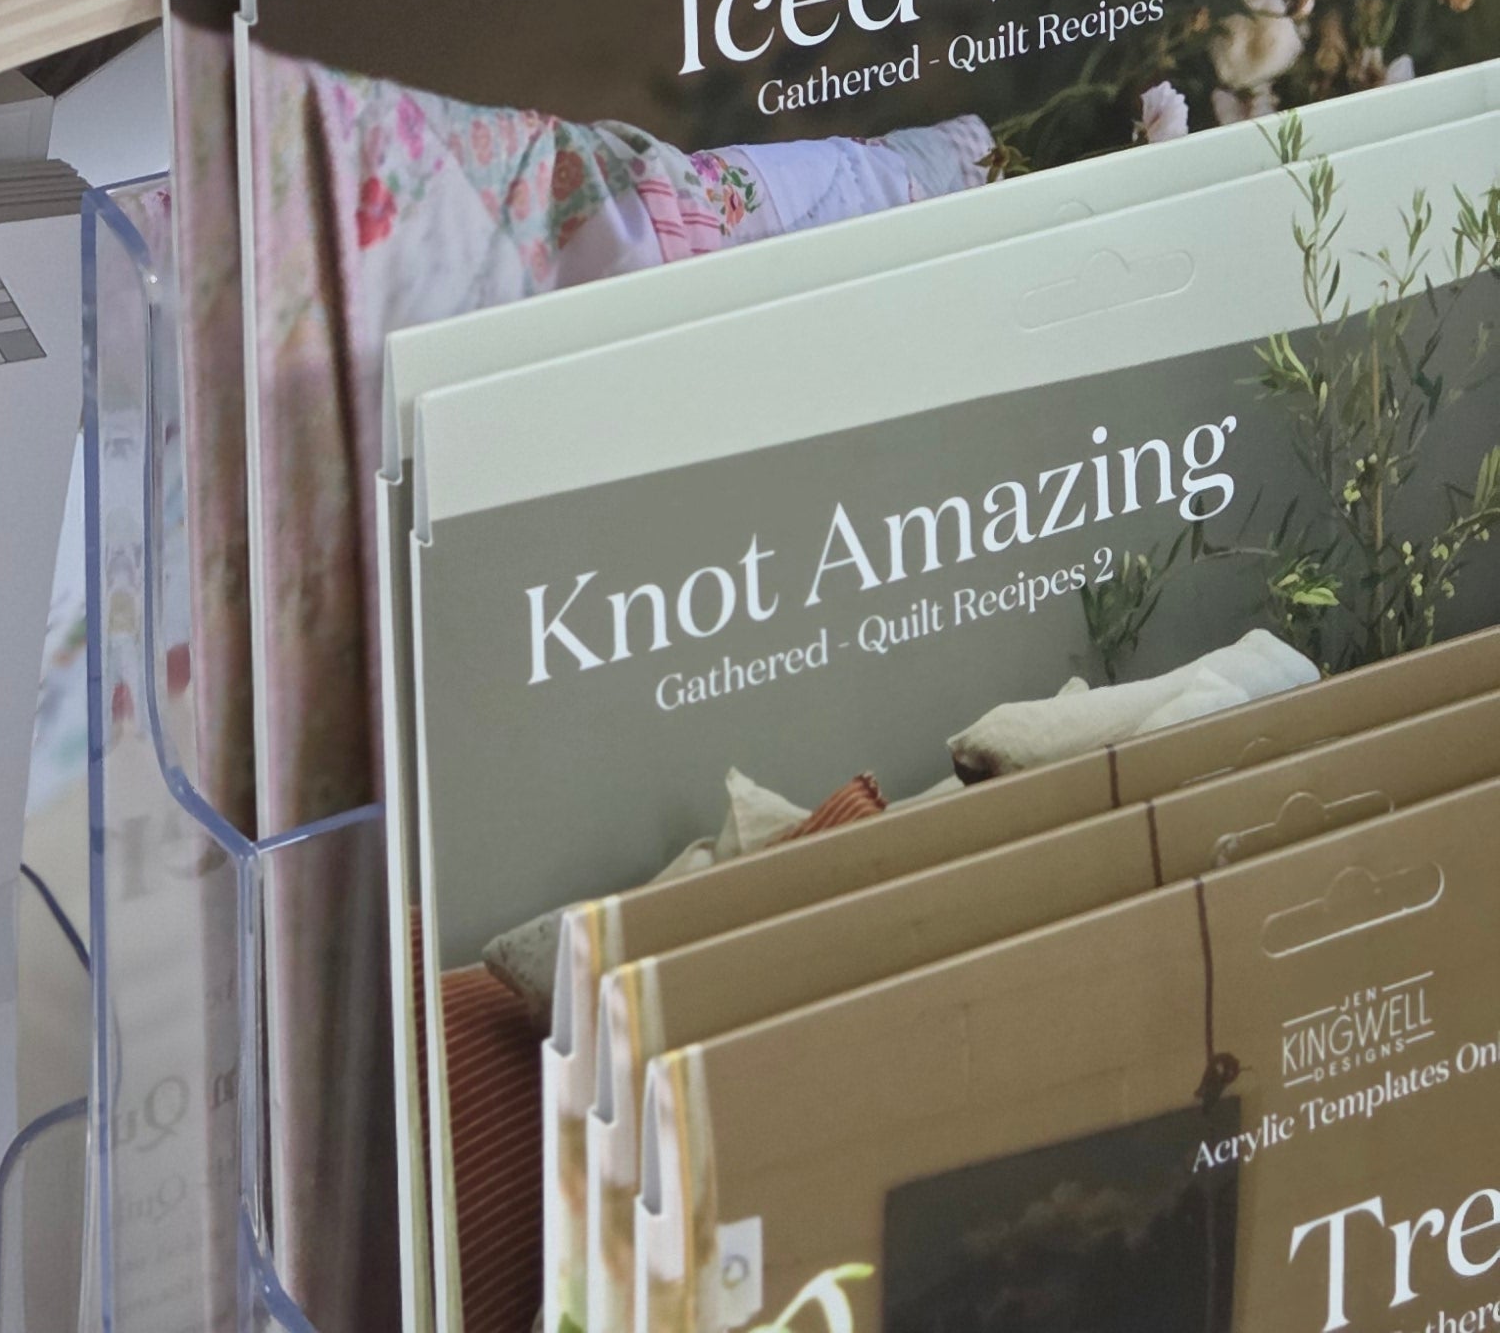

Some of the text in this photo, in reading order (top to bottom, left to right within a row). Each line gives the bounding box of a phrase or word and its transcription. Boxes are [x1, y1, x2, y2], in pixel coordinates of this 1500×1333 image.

[757, 44, 920, 116] Gathered
[948, 23, 1030, 72] Quilt
[524, 415, 1238, 685] Knot Amazing
[655, 628, 829, 712] Gathered
[857, 597, 945, 655] Quilt
[952, 561, 1087, 627] Recipes
[1094, 546, 1115, 583] 2
[1282, 988, 1433, 1076] KINGWELL
[1339, 987, 1378, 1013] JEN
[1313, 1037, 1406, 1083] DESIGNS
[1192, 1112, 1295, 1173] Acrylic
[1300, 1059, 1450, 1132] Templates
[1288, 1188, 1500, 1333] Tre
